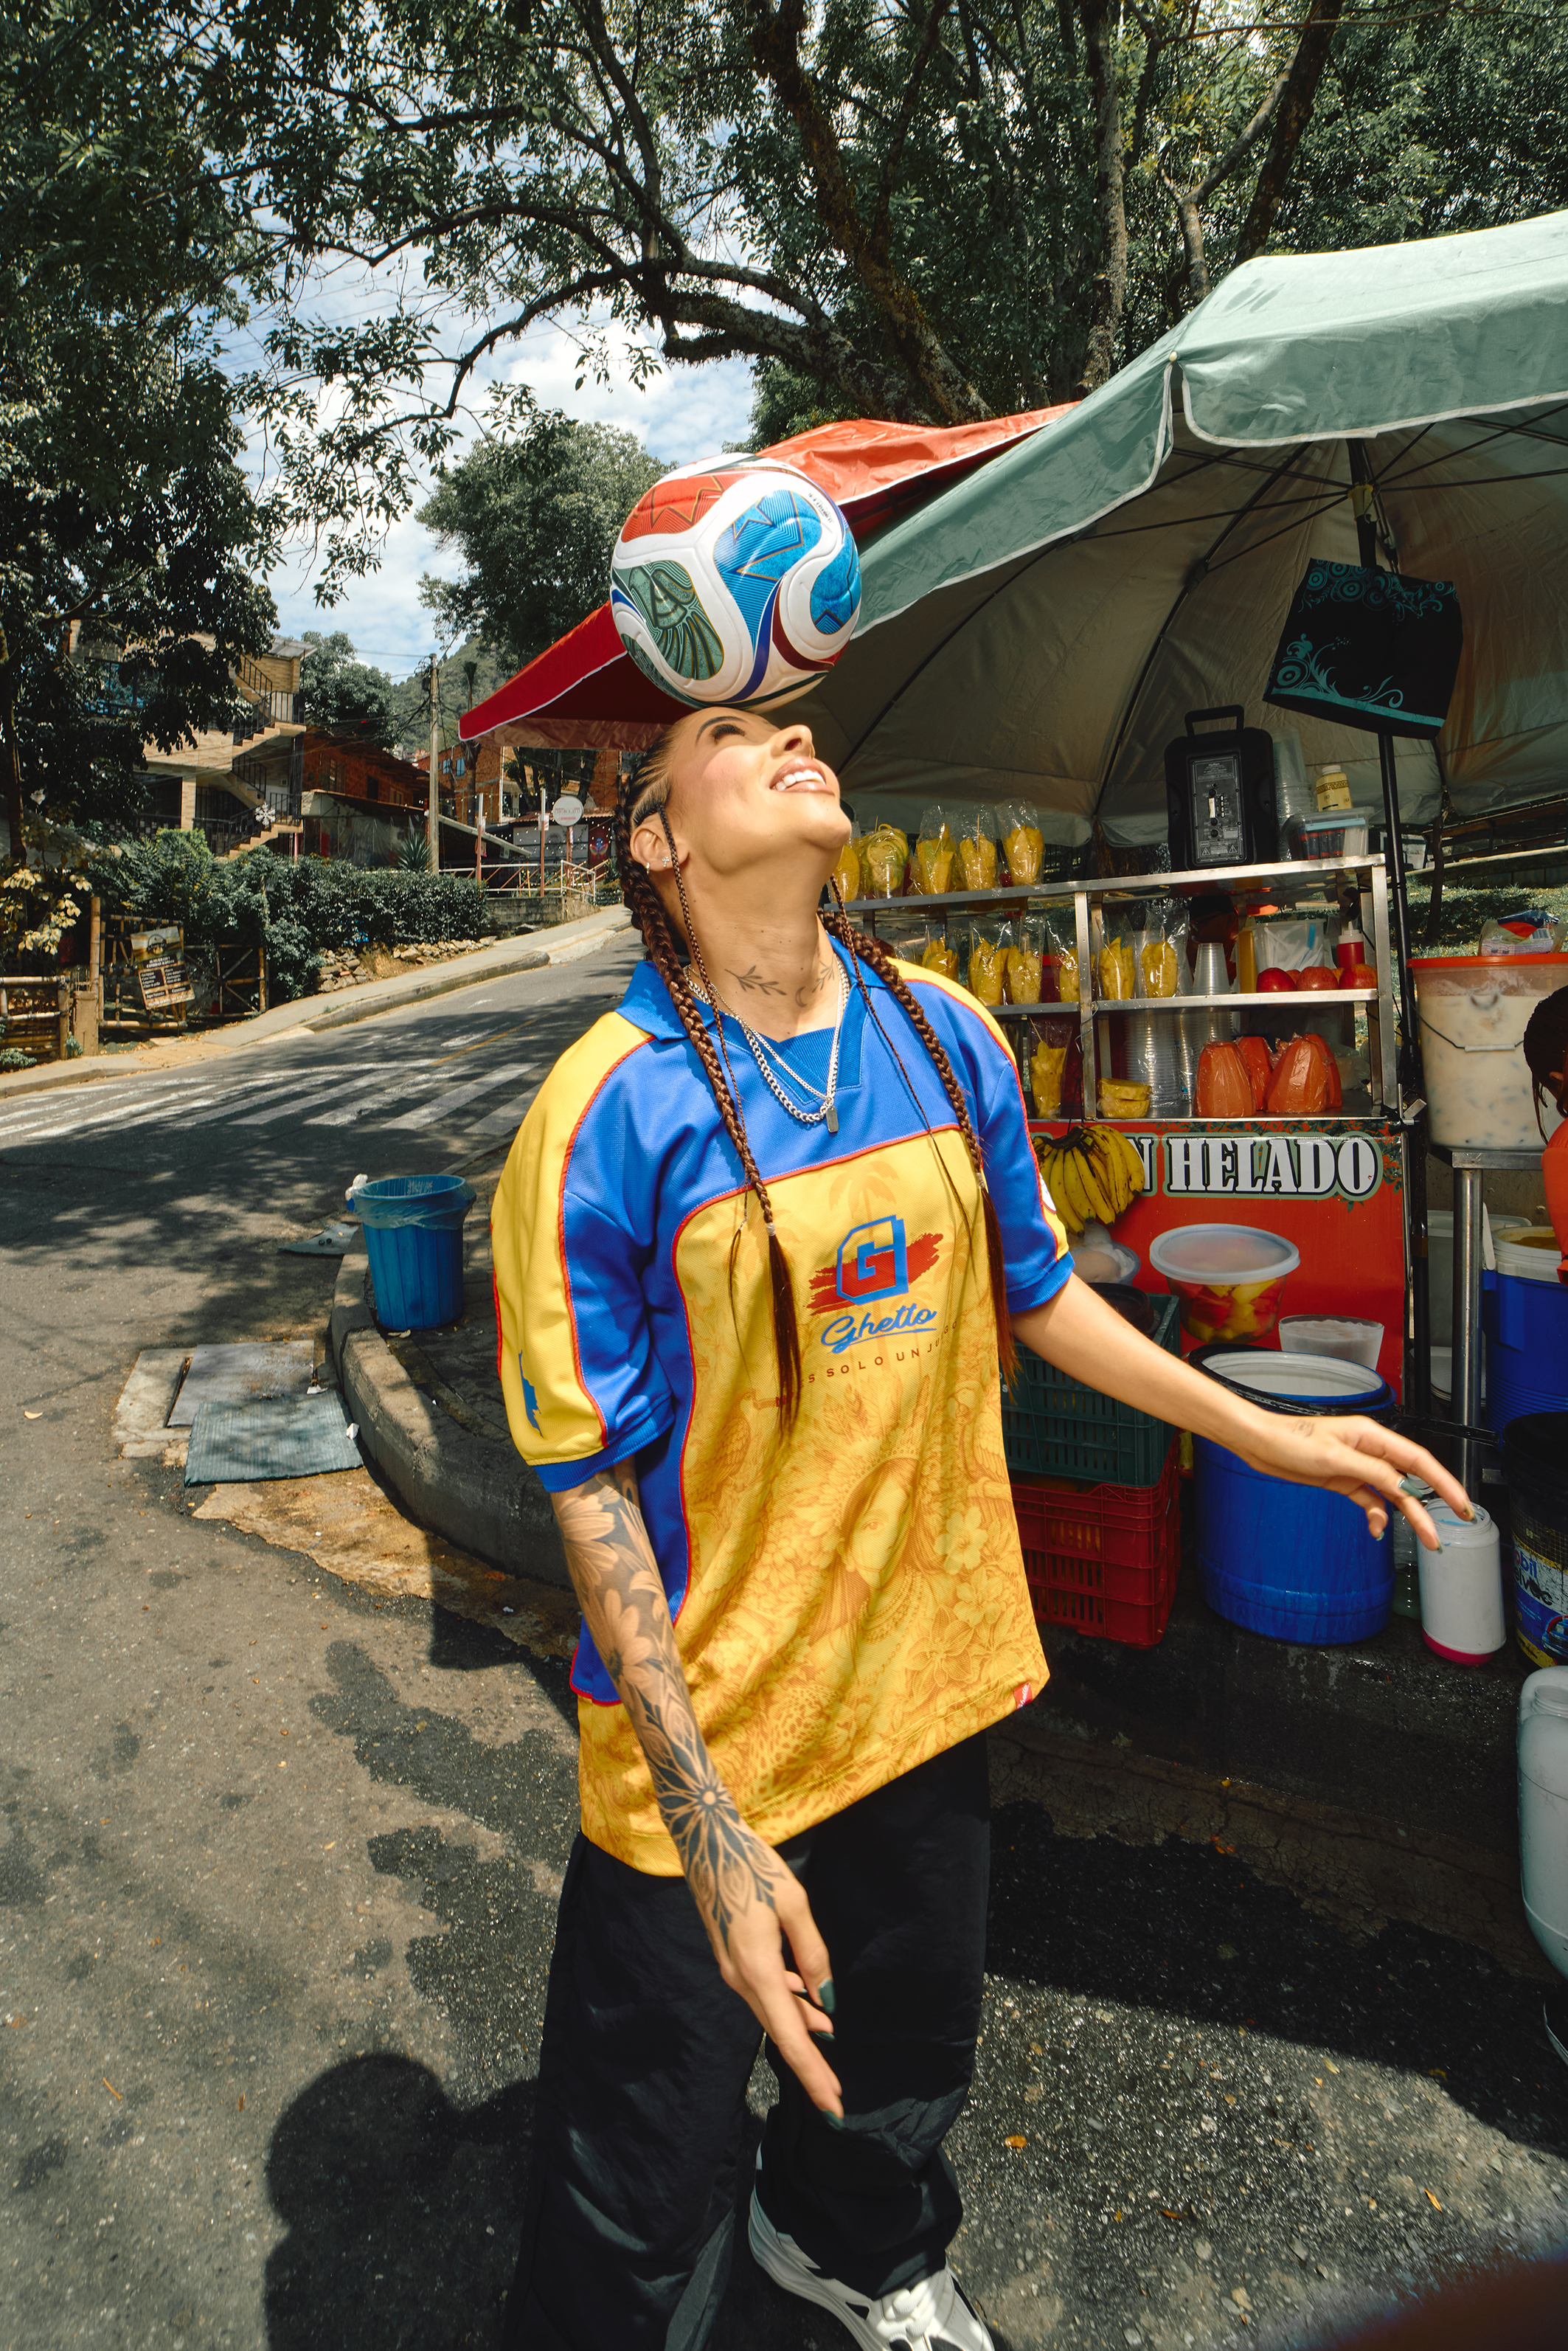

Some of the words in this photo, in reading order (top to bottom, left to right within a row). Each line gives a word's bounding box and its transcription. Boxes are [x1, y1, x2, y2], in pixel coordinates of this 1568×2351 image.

[1168, 1137, 1378, 1194] HELADO
[836, 1214, 909, 1306] G
[821, 1303, 937, 1354] Ghetto
[826, 1356, 884, 1377] SOLO
[896, 1348, 920, 1361] UN
[1514, 1550, 1537, 1579] obil
[1514, 1567, 1553, 1606] elvac
